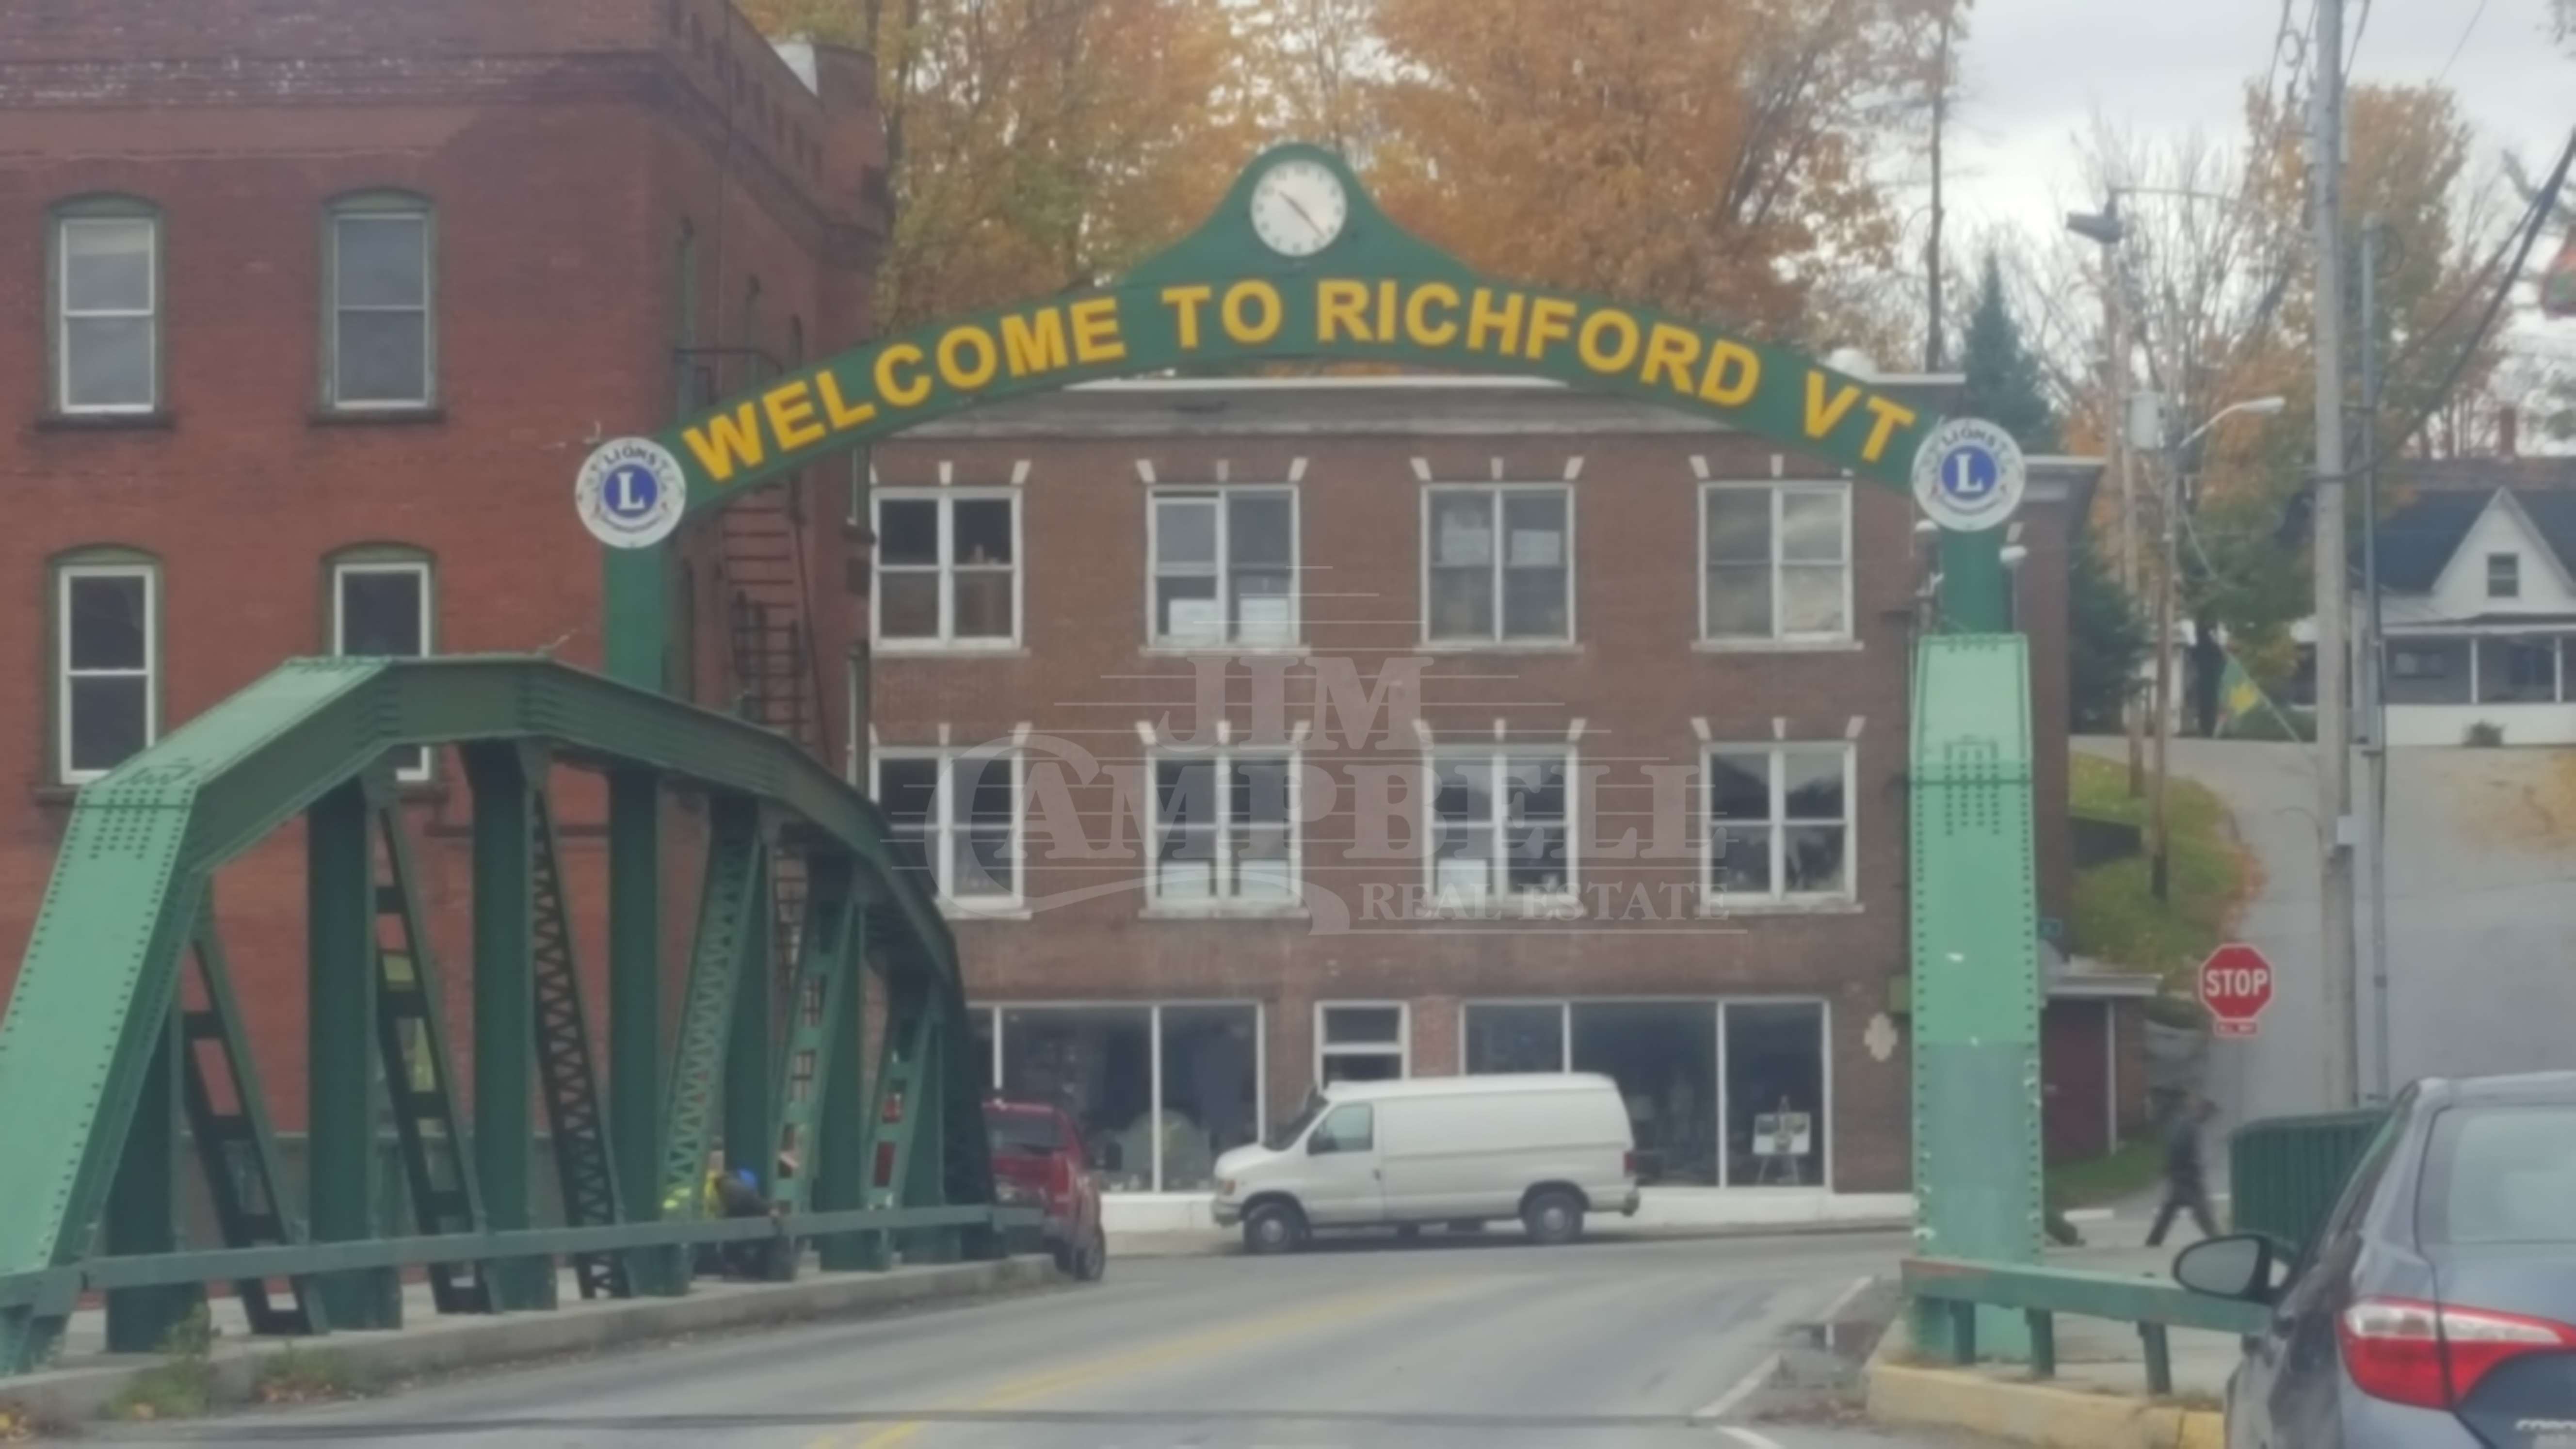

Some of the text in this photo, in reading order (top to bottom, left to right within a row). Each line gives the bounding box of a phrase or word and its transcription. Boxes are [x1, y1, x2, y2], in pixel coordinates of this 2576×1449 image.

[683, 281, 1914, 481] WELCOME TO RICHFORD VT
[1941, 426, 1996, 447] LIONS
[603, 445, 657, 465] LIONS
[1955, 453, 1984, 493] L
[617, 472, 646, 510] L
[2206, 967, 2268, 998] STOP
